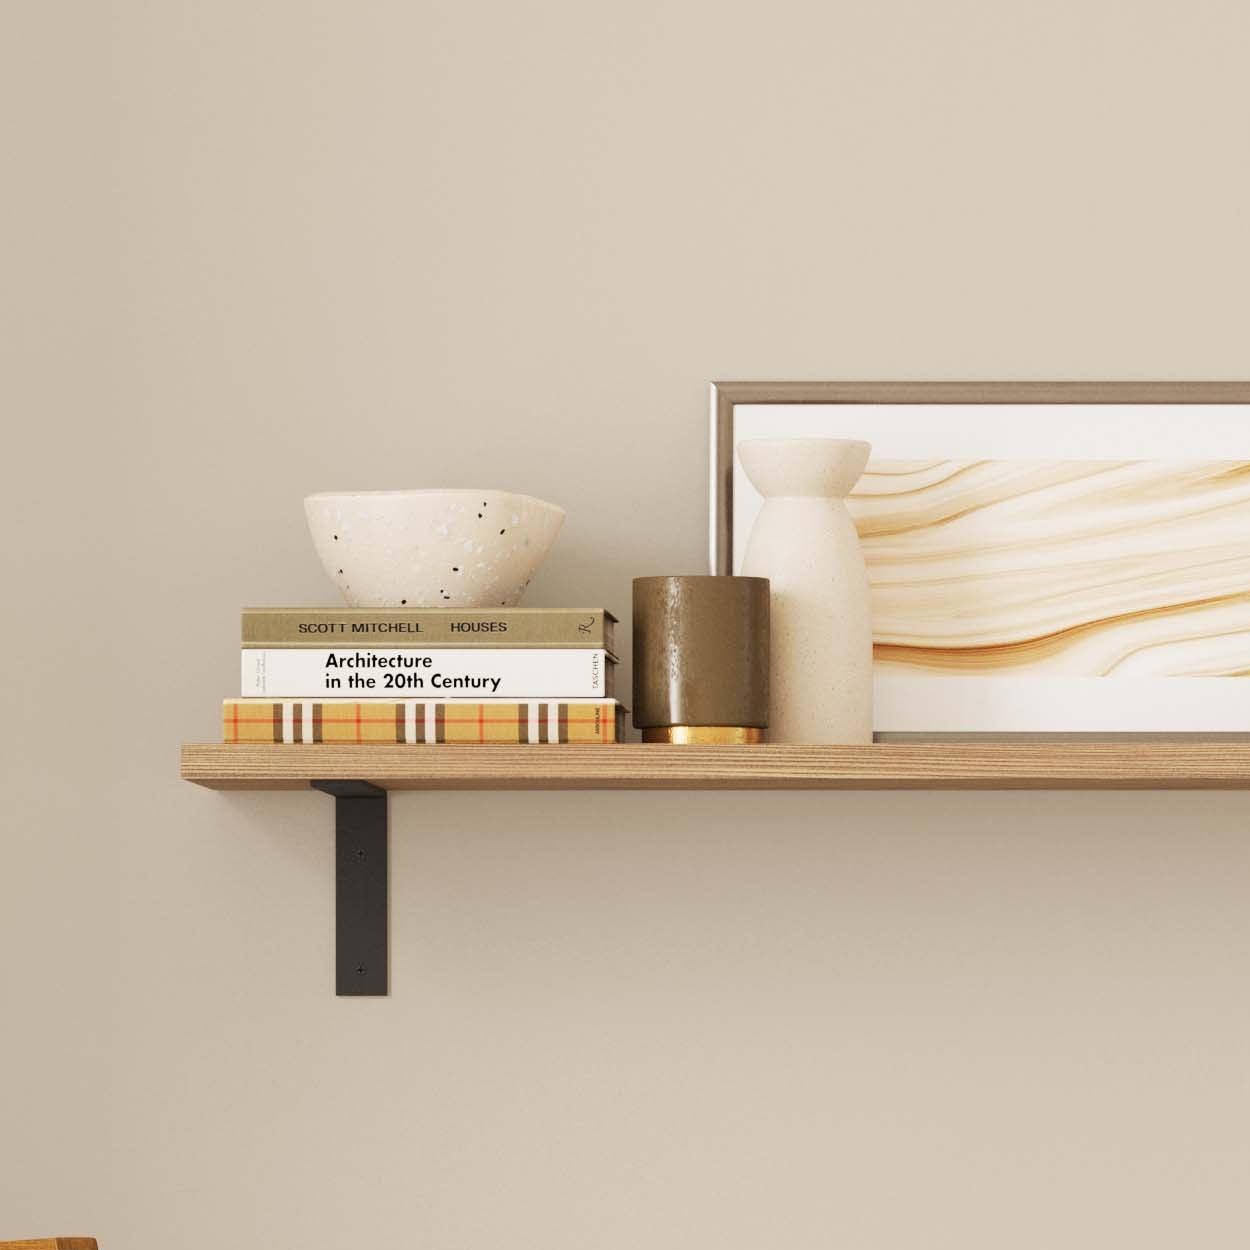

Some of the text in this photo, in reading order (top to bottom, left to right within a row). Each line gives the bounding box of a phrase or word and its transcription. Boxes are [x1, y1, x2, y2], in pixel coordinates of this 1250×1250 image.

[298, 622, 507, 633] SCOTT MITCHELL HOUSES
[325, 654, 432, 668] Architecture
[325, 673, 501, 692] in the 20th Century
